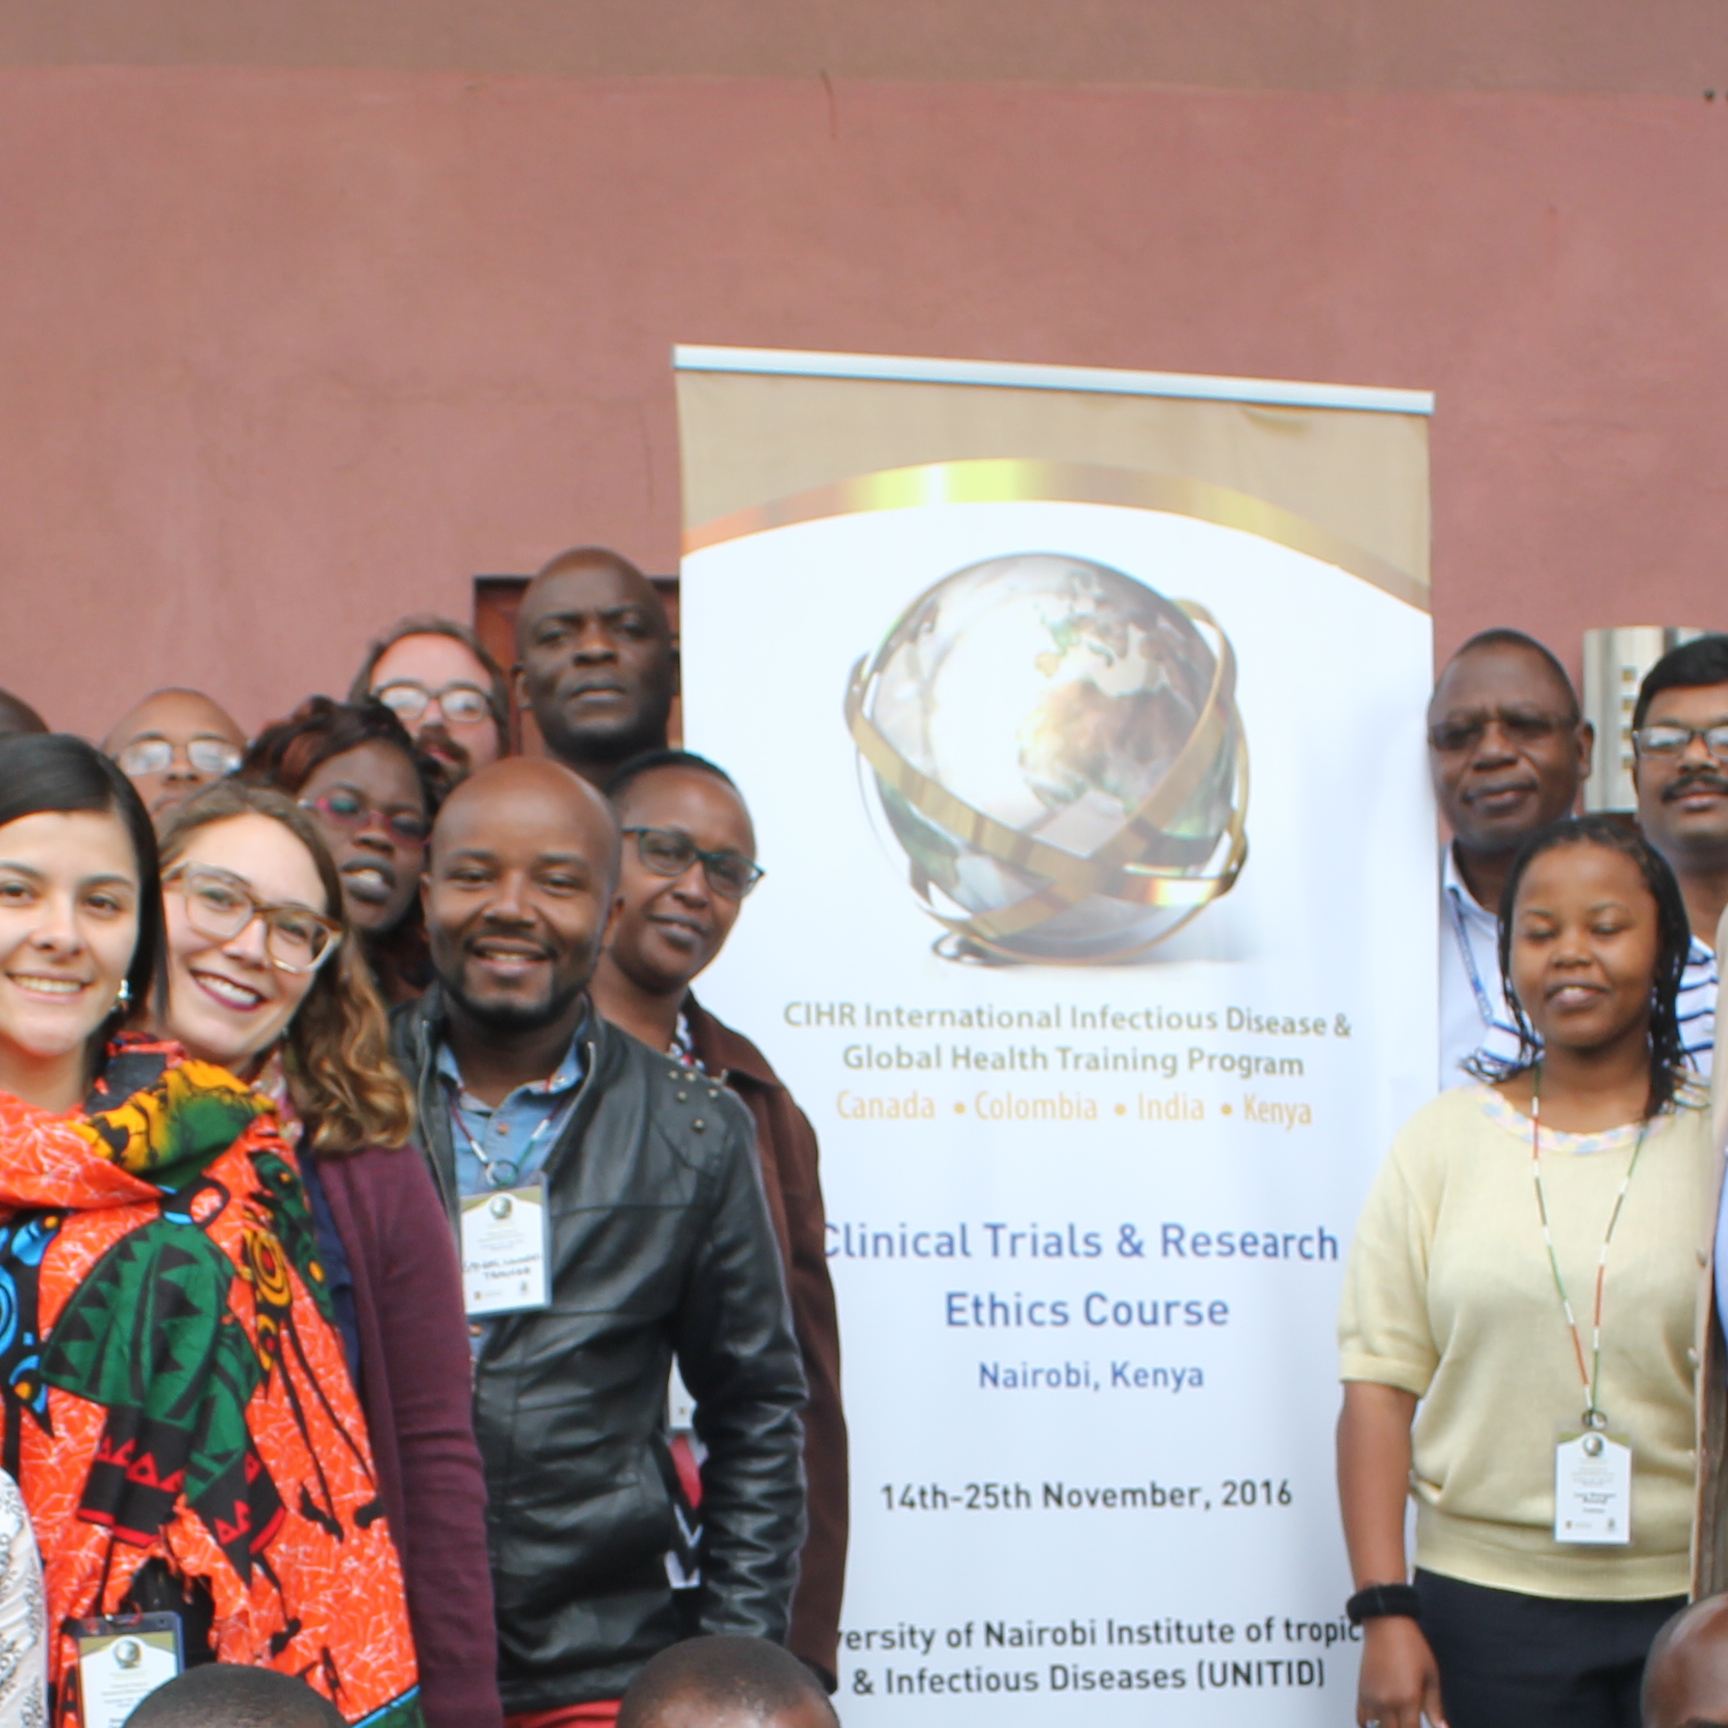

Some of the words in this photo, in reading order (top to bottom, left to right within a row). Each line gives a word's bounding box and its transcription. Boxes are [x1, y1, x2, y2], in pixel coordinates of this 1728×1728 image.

[783, 1002, 858, 1029] CIHR
[865, 1004, 1062, 1031] International
[1071, 1006, 1219, 1032] Infectious
[1227, 1007, 1328, 1038] Disease
[1334, 1013, 1352, 1038] &
[843, 1045, 943, 1072] Global
[951, 1046, 1048, 1073] Health
[1056, 1047, 1179, 1080] Training
[1189, 1048, 1306, 1080] Program
[836, 1090, 937, 1121] Canada
[975, 1092, 1099, 1122] Colombia
[1138, 1094, 1206, 1122] India
[1244, 1095, 1313, 1130] Kenya
[824, 1222, 970, 1260] Clinical
[984, 1222, 1104, 1259] Trials
[1117, 1223, 1146, 1260] &
[1162, 1224, 1339, 1261] Research
[946, 1291, 1071, 1328] Ethics
[1084, 1292, 1230, 1328] Course
[979, 1361, 1101, 1393] Nairobi,
[1110, 1362, 1205, 1394] Kenya
[881, 1482, 1033, 1512] 14th-25th
[1043, 1480, 1213, 1513] November,
[1222, 1479, 1294, 1508] 2016
[838, 1622, 937, 1656] ersity
[945, 1621, 976, 1650] of
[984, 1620, 1098, 1649] Nairobi
[1106, 1617, 1237, 1647] Institute
[1245, 1616, 1276, 1645] of
[852, 1668, 876, 1696] &
[886, 1667, 1041, 1696] Infectious
[1050, 1664, 1188, 1693] Diseases
[1197, 1659, 1326, 1691] (UNITID)
